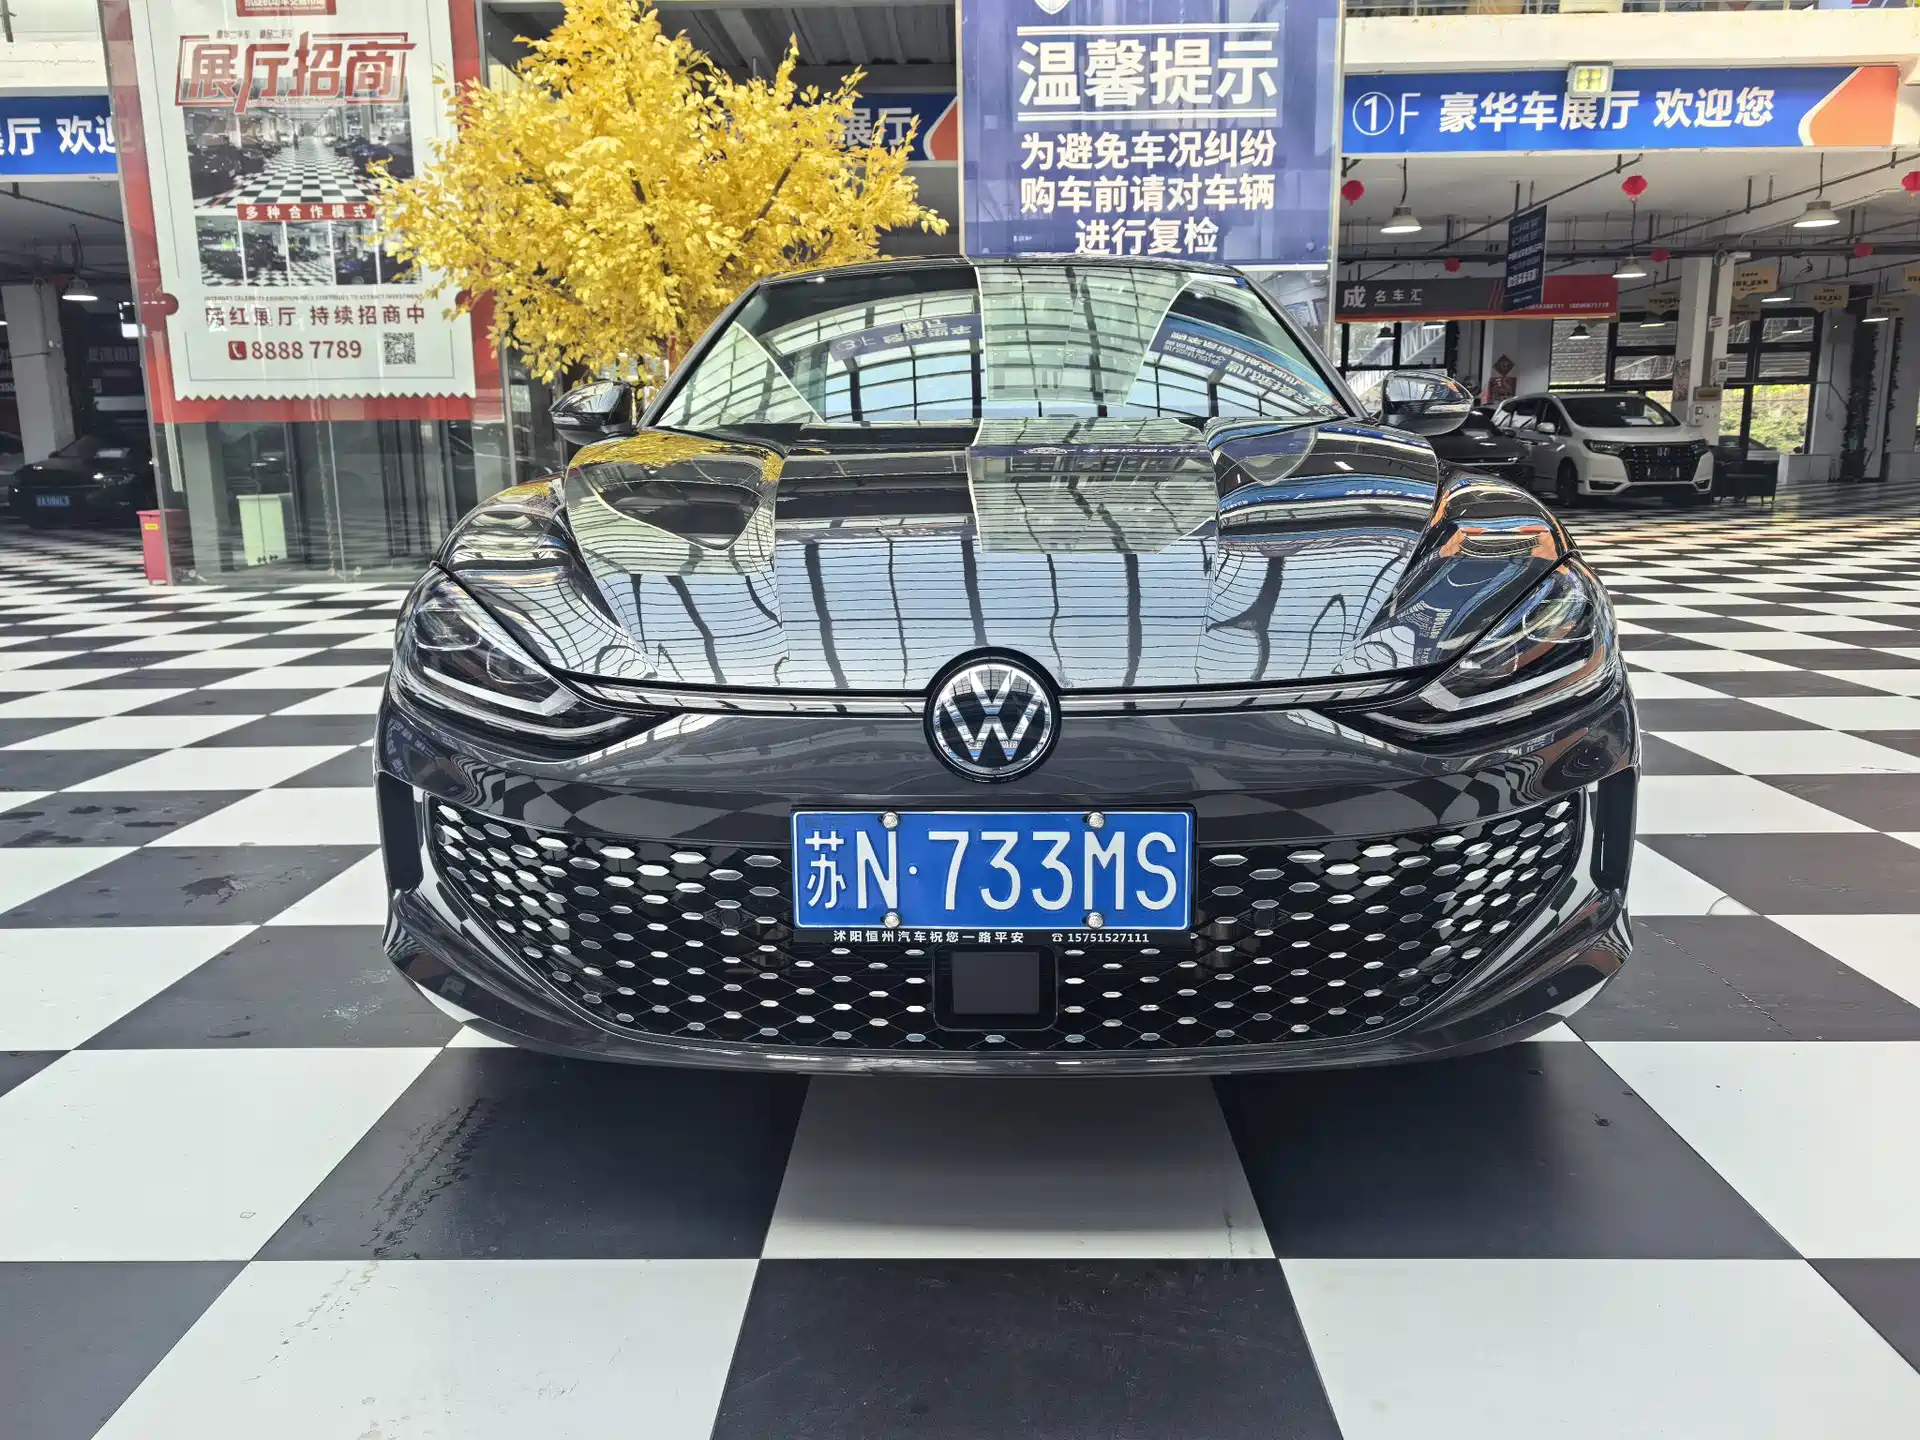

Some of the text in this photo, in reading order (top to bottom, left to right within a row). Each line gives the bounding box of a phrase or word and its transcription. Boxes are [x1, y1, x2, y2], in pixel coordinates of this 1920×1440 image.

[188, 31, 417, 114] 展厅招商
[1017, 38, 1278, 107] 温馨提示
[840, 107, 912, 146] 展厅
[1439, 89, 1640, 133] 豪华车展厅
[1654, 87, 1775, 129] 欢迎您
[0, 117, 42, 156] 厅
[1020, 130, 1277, 171] 为避免车况纠纷
[246, 204, 368, 219] 多种合作模式
[1020, 174, 1276, 214] 购车前请对车辆
[1075, 219, 1219, 255] 进行复检
[309, 305, 425, 326] 持续招商中
[252, 340, 362, 360] 8888 7789
[833, 930, 1150, 944] 沭阳恒州汽车祝您一路平安 15751527111
